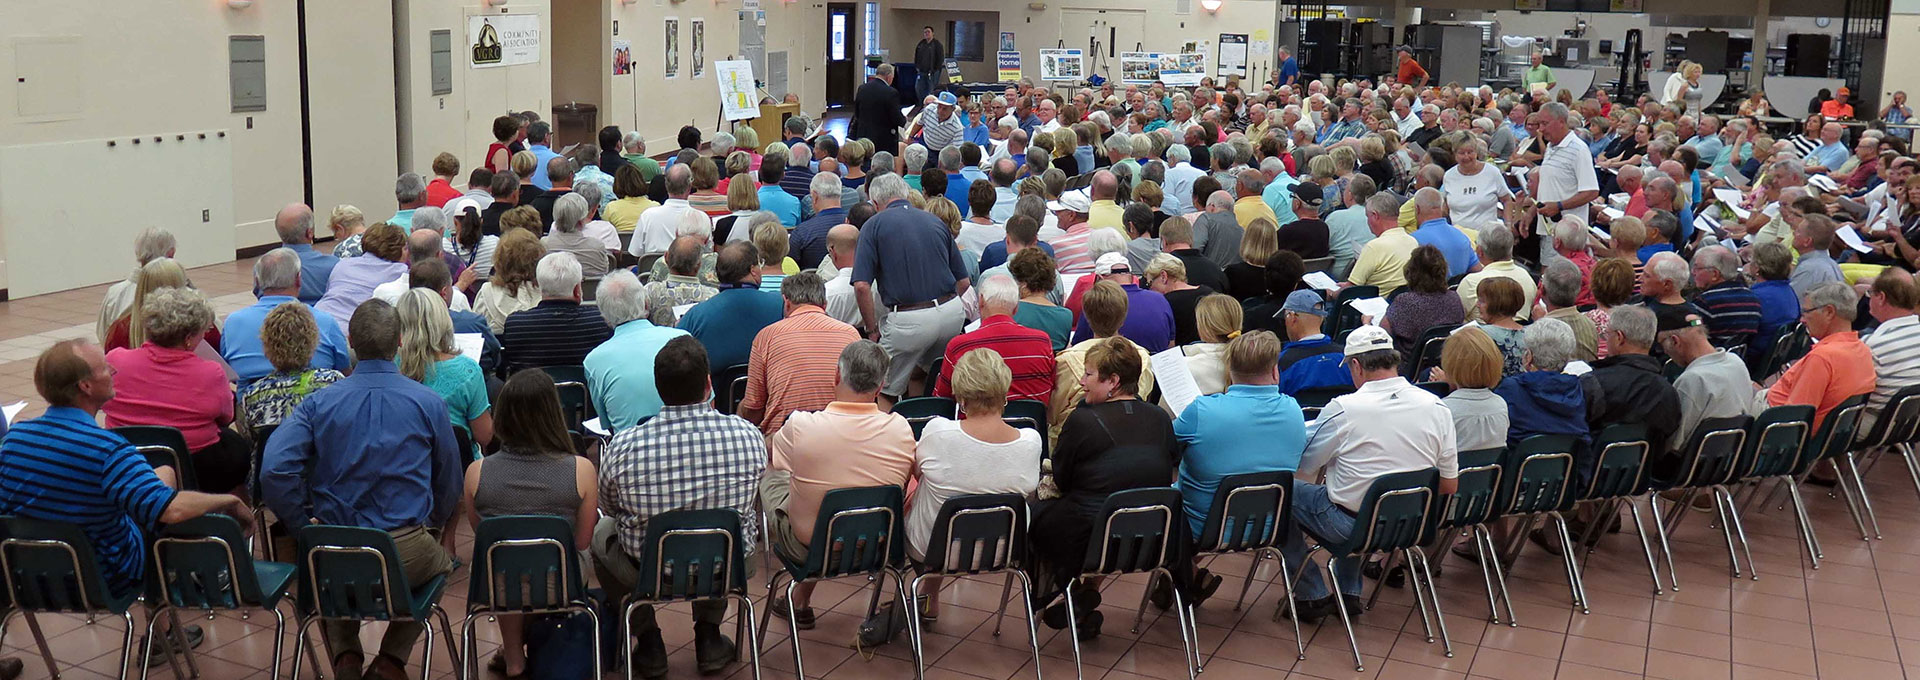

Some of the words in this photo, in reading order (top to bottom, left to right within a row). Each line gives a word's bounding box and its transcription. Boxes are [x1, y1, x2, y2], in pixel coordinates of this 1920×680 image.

[503, 30, 538, 39] COMMUNITY
[502, 39, 538, 48] ASSOCIATION
[475, 48, 500, 60] VGRC
